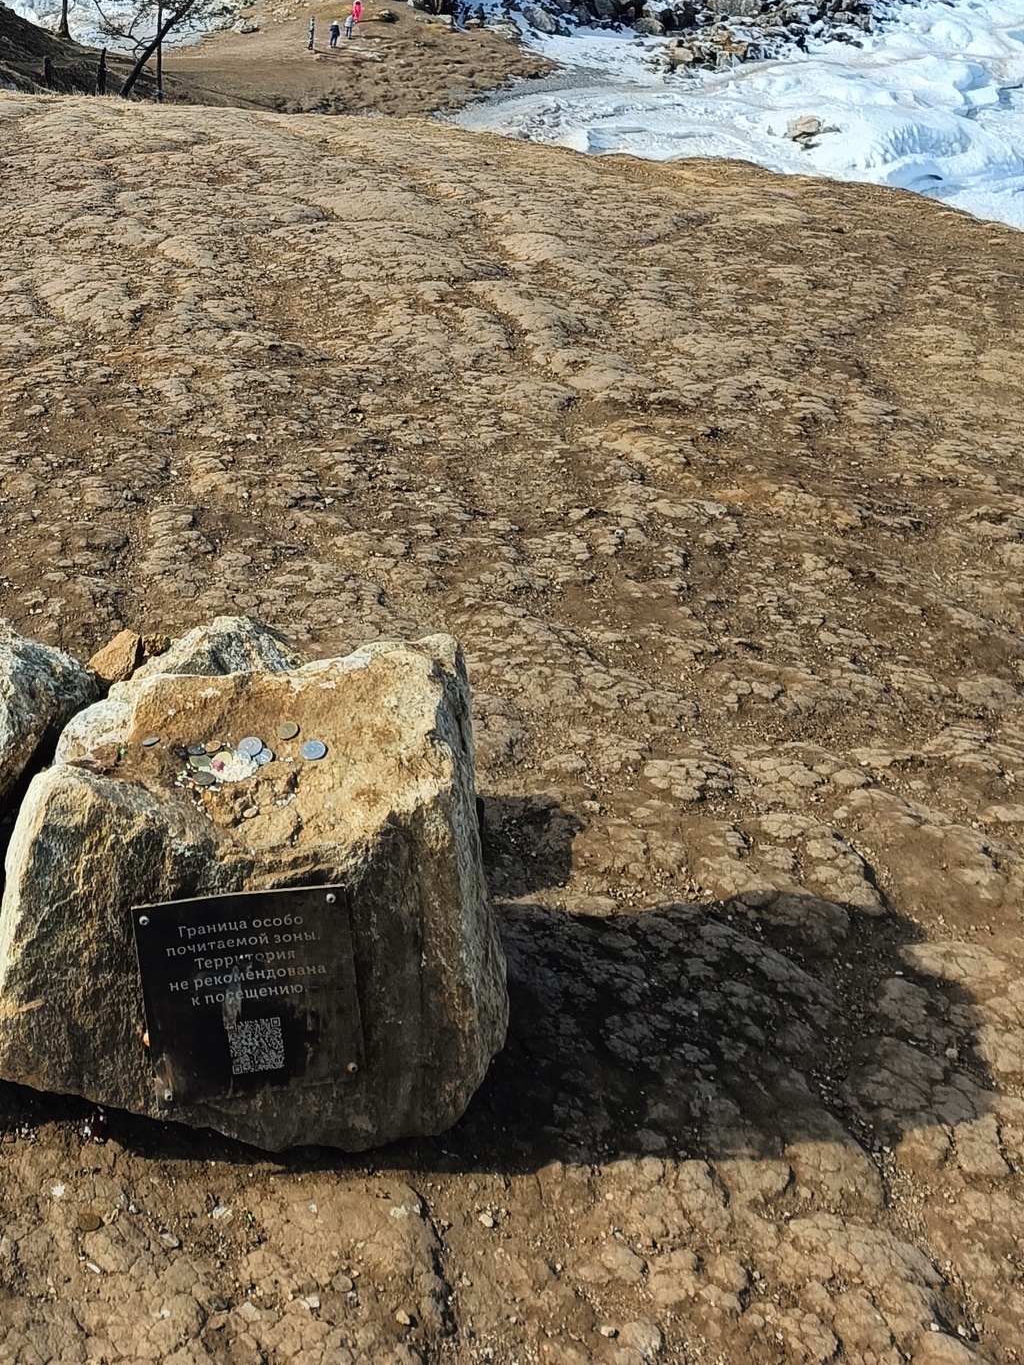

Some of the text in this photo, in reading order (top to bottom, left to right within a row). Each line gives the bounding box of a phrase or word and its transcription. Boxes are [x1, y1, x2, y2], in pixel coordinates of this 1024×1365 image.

[178, 913, 304, 939] Граница особо
[166, 932, 321, 957] почитаемой зоны.
[169, 964, 327, 992] не рекомендована
[191, 996, 201, 1007] к
